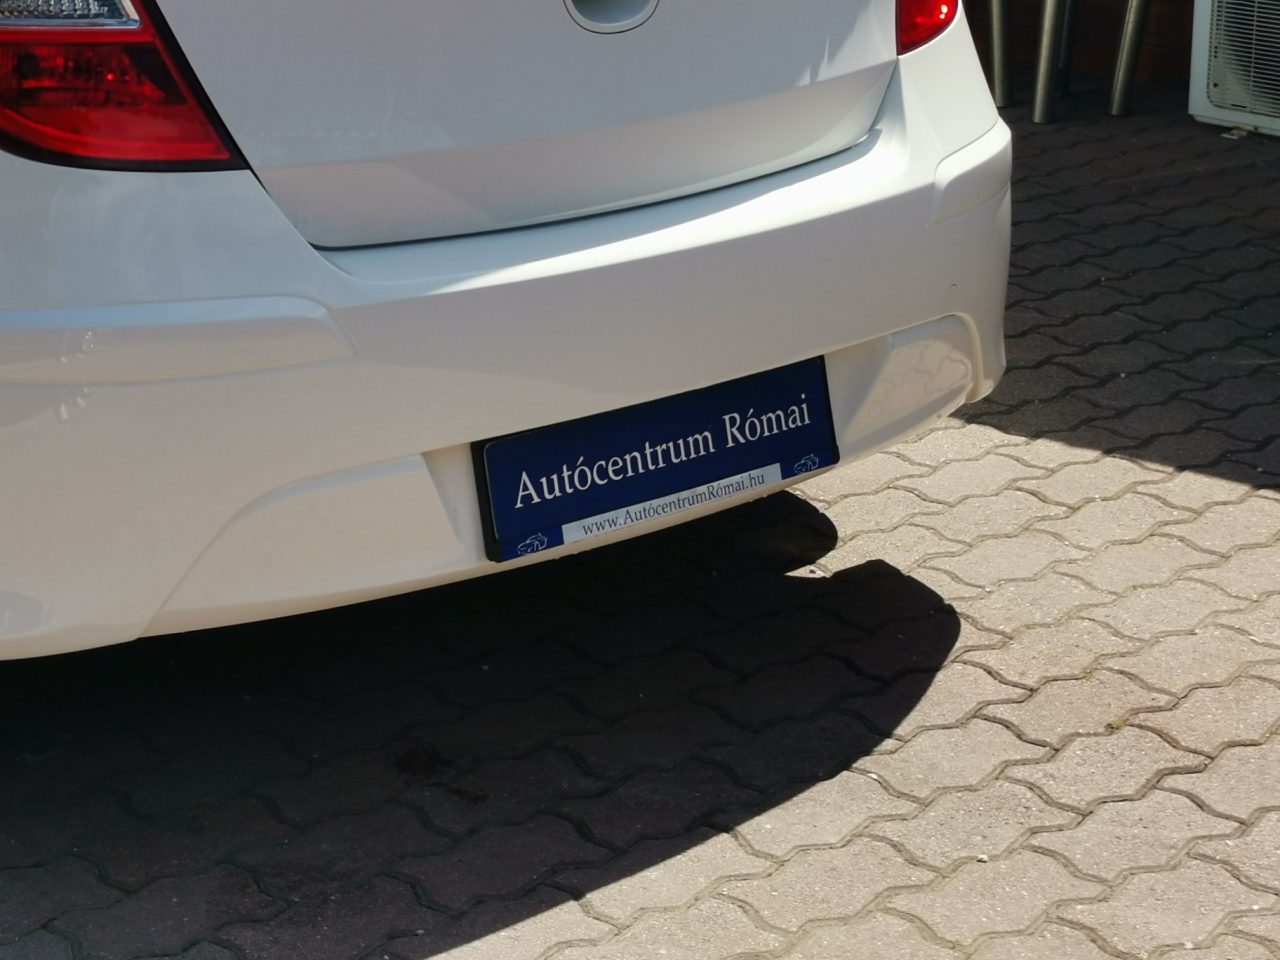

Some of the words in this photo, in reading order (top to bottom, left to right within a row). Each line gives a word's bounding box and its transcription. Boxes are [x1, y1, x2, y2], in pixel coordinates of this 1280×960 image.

[514, 428, 716, 509] Autócentrum
[722, 393, 811, 448] Római
[582, 473, 766, 536] www.AutócentrumRómai.hu
